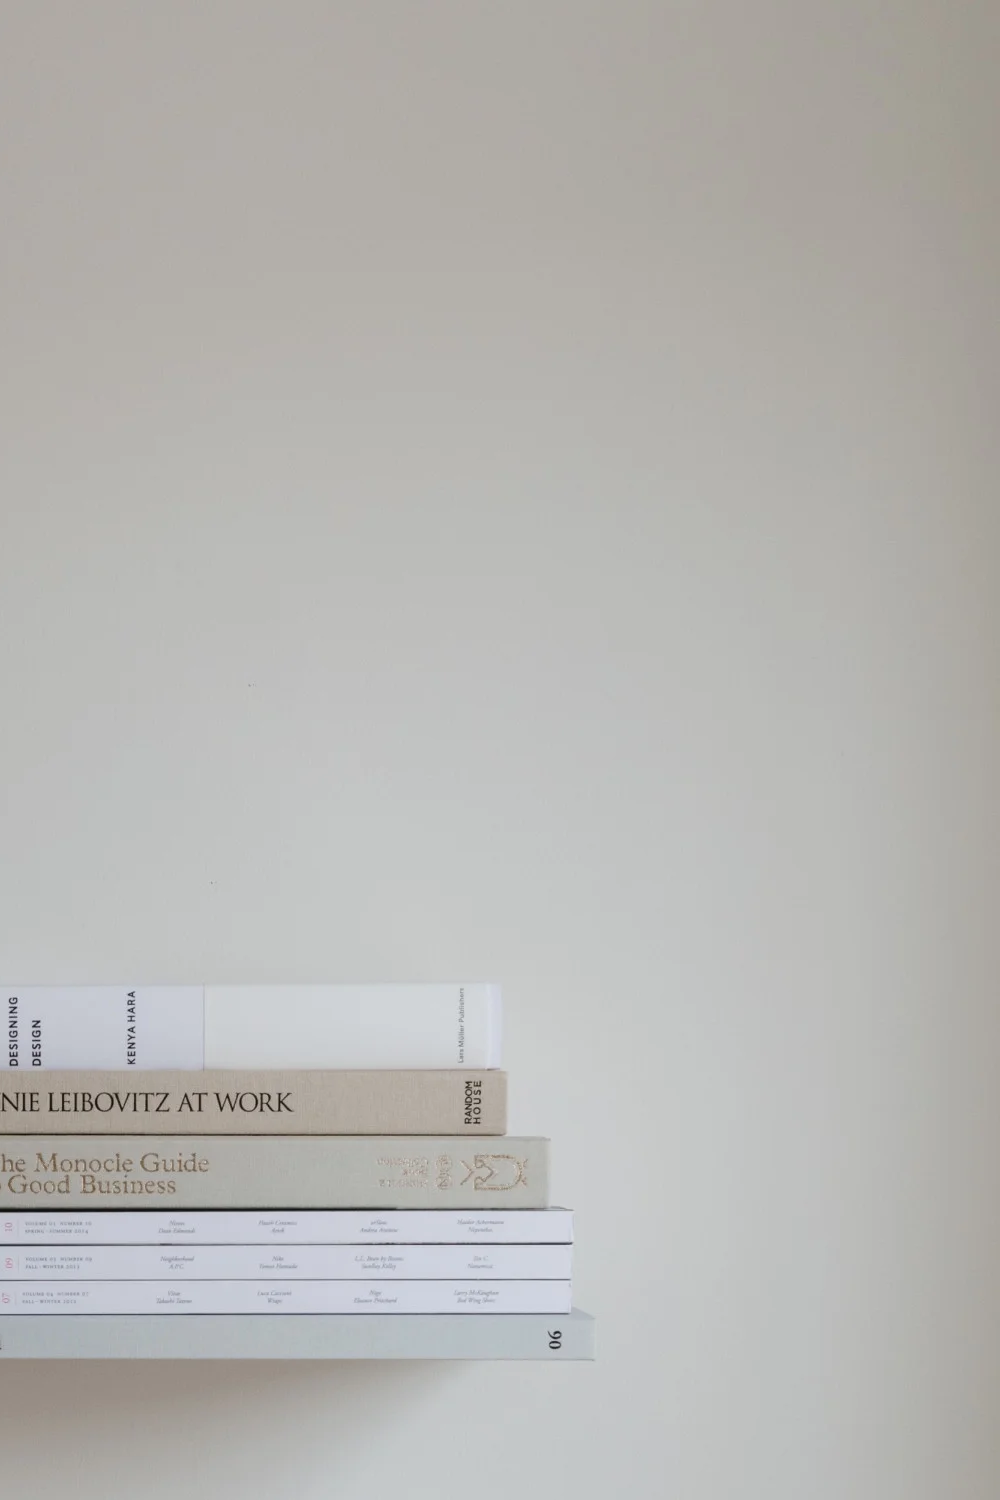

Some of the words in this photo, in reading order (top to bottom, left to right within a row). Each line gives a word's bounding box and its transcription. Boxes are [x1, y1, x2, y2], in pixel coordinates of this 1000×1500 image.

[127, 991, 136, 1022] HARA
[9, 997, 18, 1067] DESIGNING
[31, 1020, 41, 1067] DESIGN
[127, 1026, 136, 1065] KENYA
[48, 1092, 170, 1112] LEIBOVITZ
[177, 1092, 208, 1112] AT
[214, 1092, 295, 1112] WORK
[465, 1081, 473, 1124] RANDOM
[473, 1080, 482, 1124] HOUSE
[34, 1152, 133, 1172] Monocle
[140, 1152, 210, 1172] Guide
[7, 1175, 71, 1194] Good
[80, 1174, 177, 1194] Business
[4, 1222, 13, 1232] 10
[4, 1257, 13, 1269] 09
[2, 1292, 10, 1304] 07
[547, 1330, 562, 1350] 06
